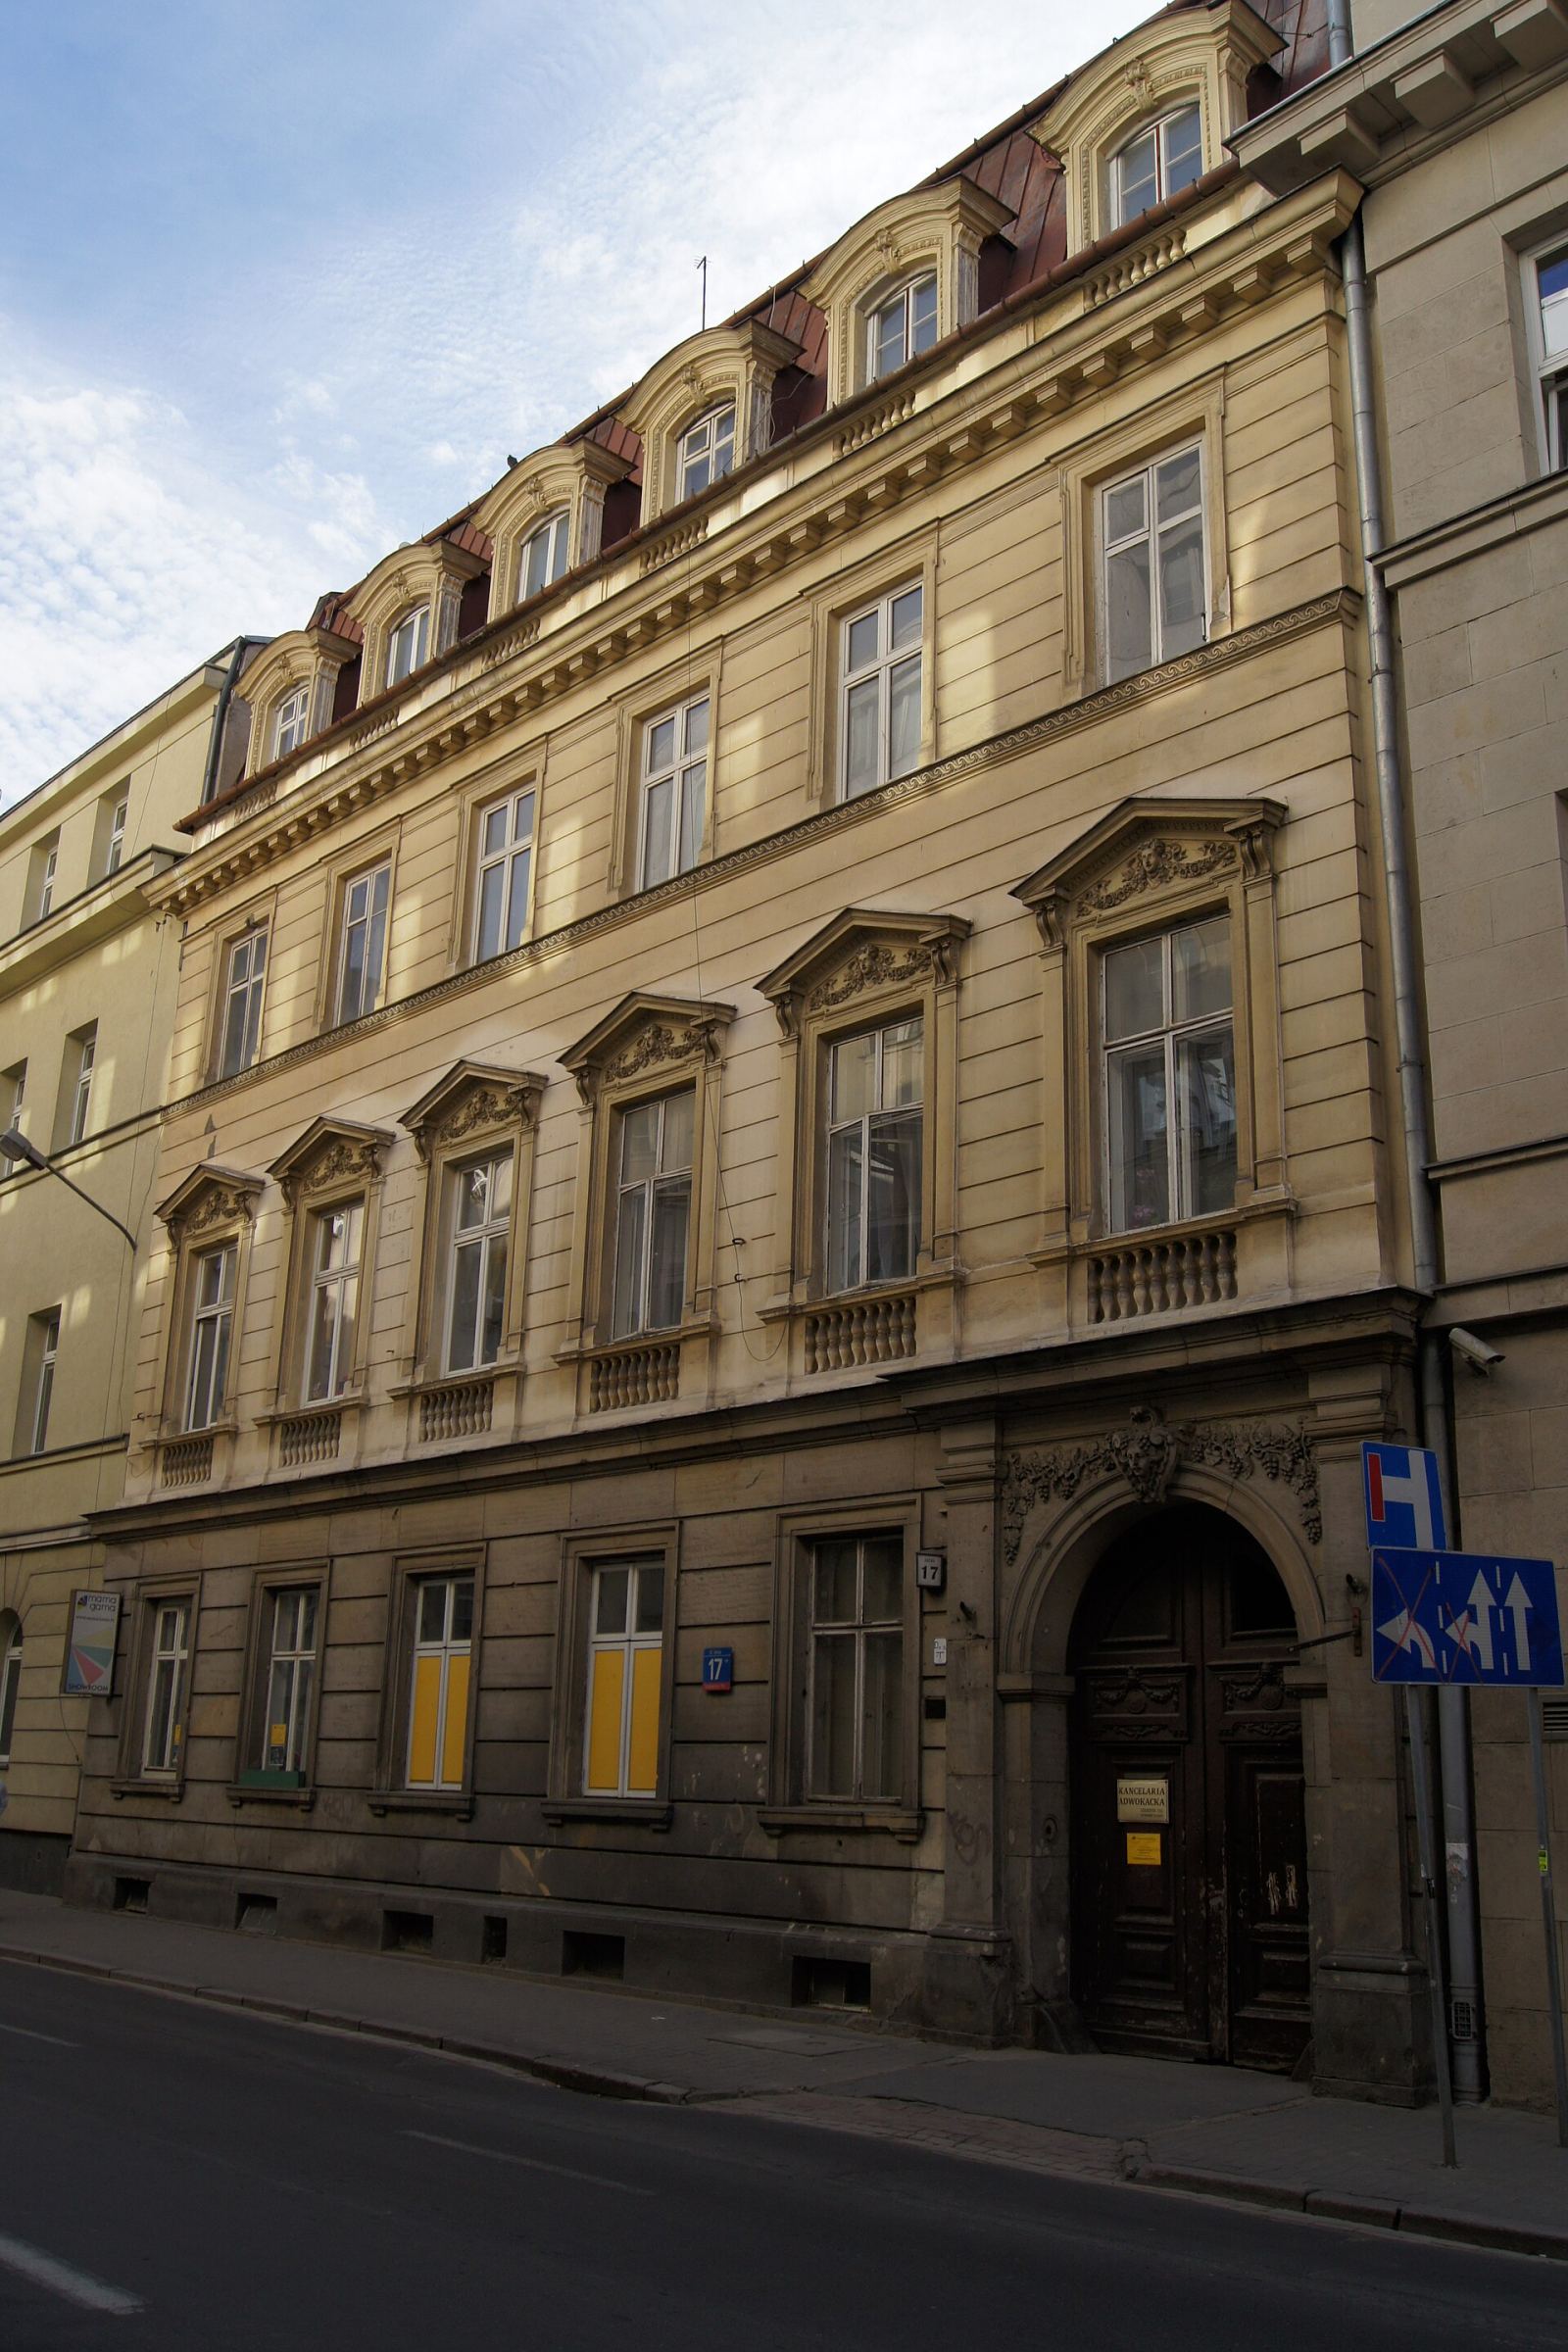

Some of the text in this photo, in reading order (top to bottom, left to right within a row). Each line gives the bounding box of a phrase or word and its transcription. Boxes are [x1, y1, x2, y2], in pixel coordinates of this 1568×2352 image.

[921, 1565, 939, 1580] 17
[89, 1595, 117, 1604] mama
[89, 1603, 116, 1612] gama
[708, 1658, 723, 1681] 17
[1118, 1787, 1165, 1795] KANCELARIA
[1119, 1797, 1165, 1806] ADWOKACKA
